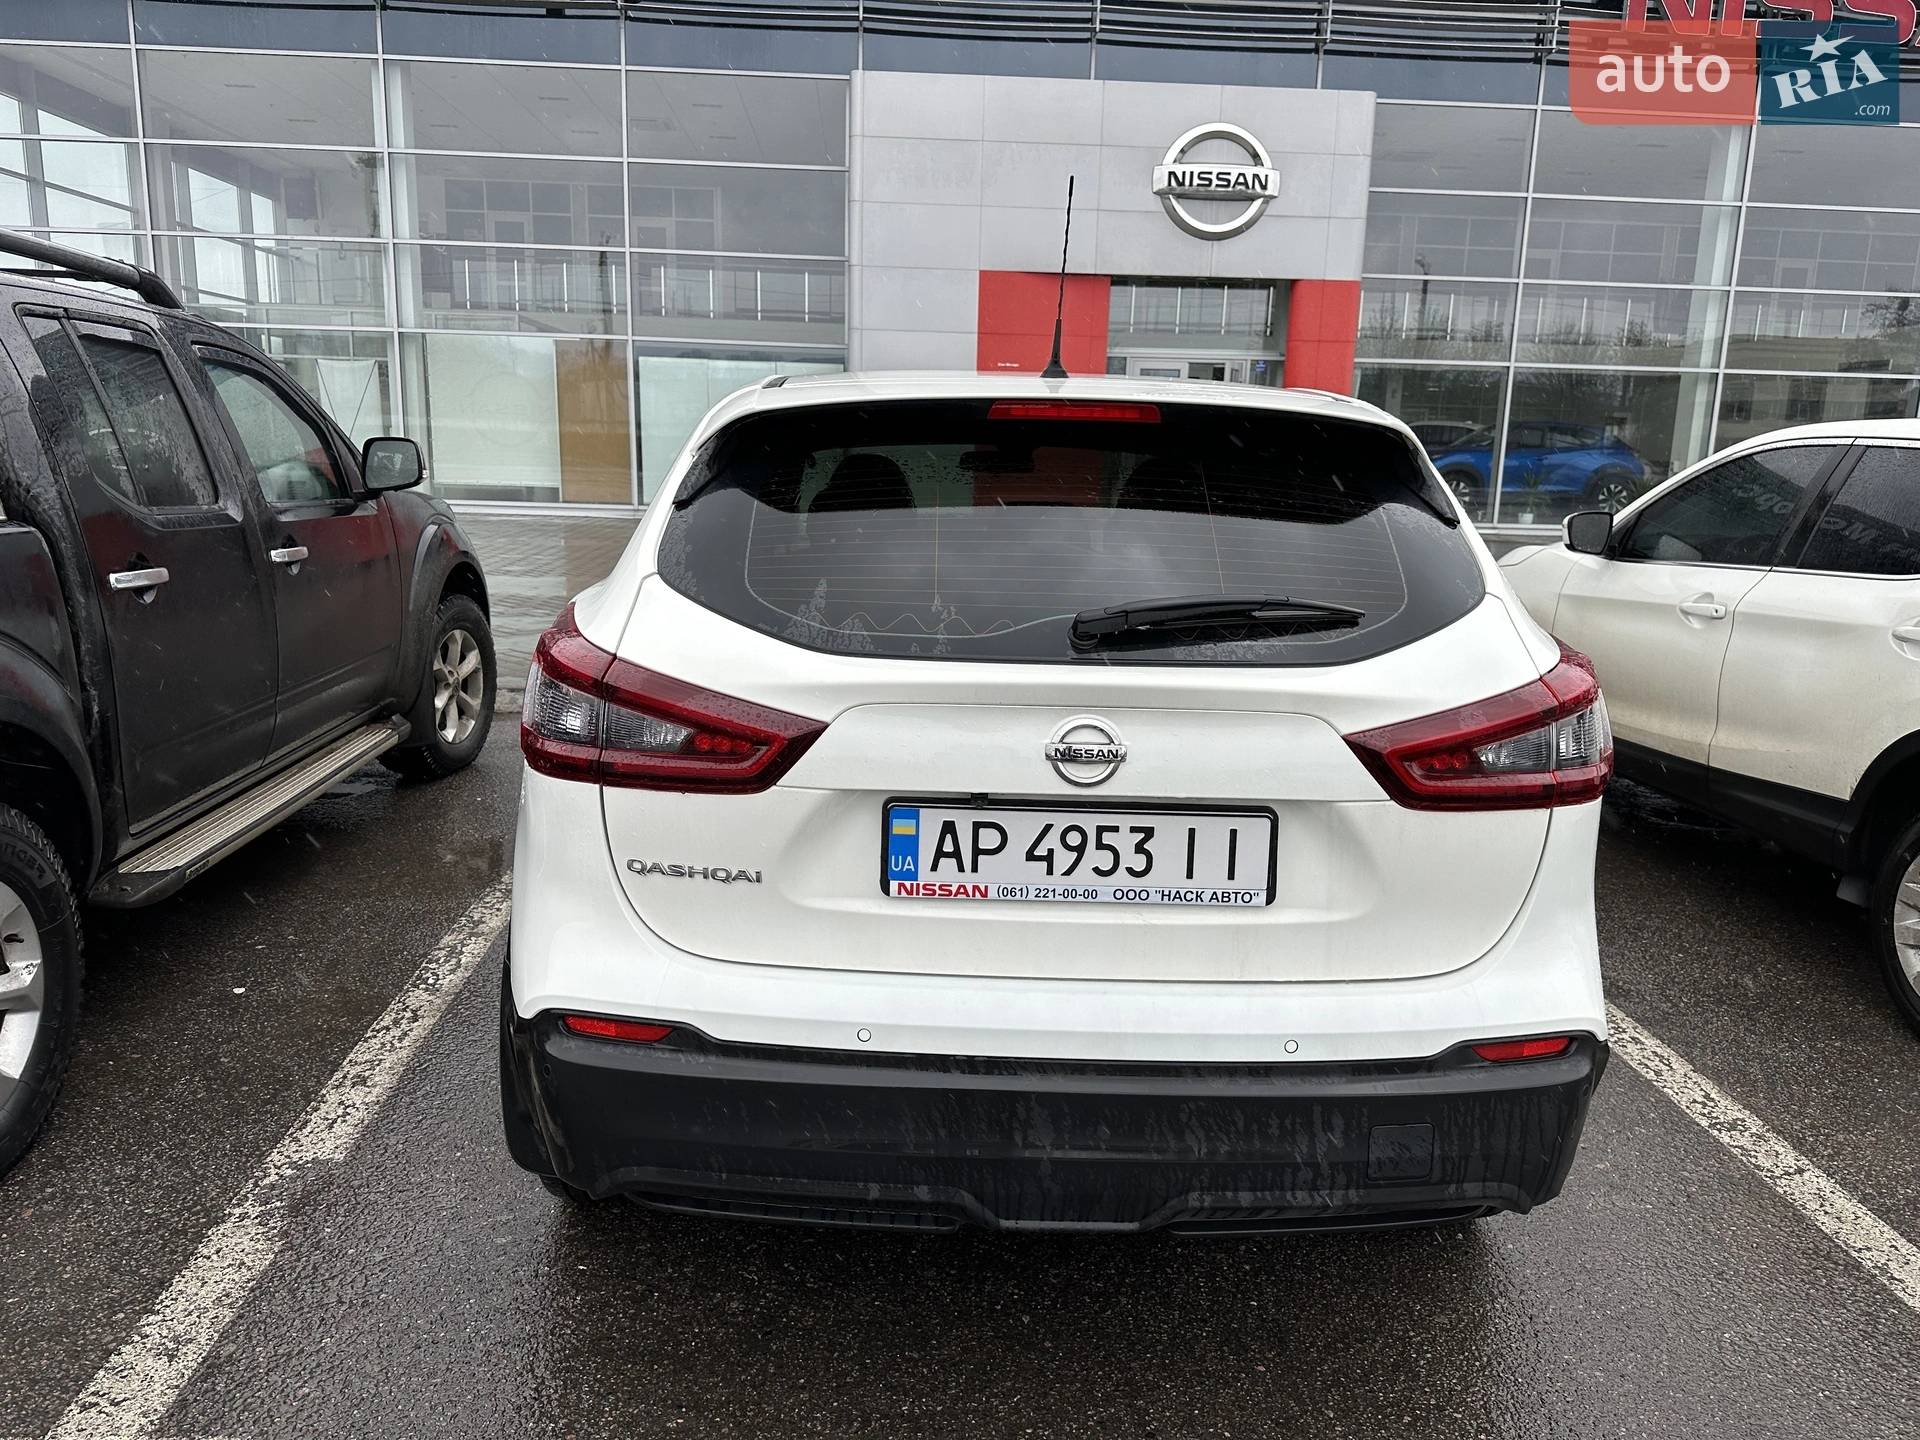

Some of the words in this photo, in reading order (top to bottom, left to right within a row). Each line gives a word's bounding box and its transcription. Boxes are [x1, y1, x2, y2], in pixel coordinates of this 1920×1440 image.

[1167, 171, 1269, 190] NISSAN
[1054, 748, 1119, 759] NISSAN
[930, 820, 1009, 873] AP
[1025, 823, 1155, 877] 4953
[627, 858, 763, 884] QASHQAI
[891, 855, 915, 872] UA
[897, 883, 989, 899] NISSAN
[997, 885, 1030, 900] (061)
[1034, 887, 1099, 901] 221-00-00
[1113, 889, 1150, 902] ООО
[1155, 889, 1205, 903] "НАСК
[1208, 890, 1260, 905] АВТО"
